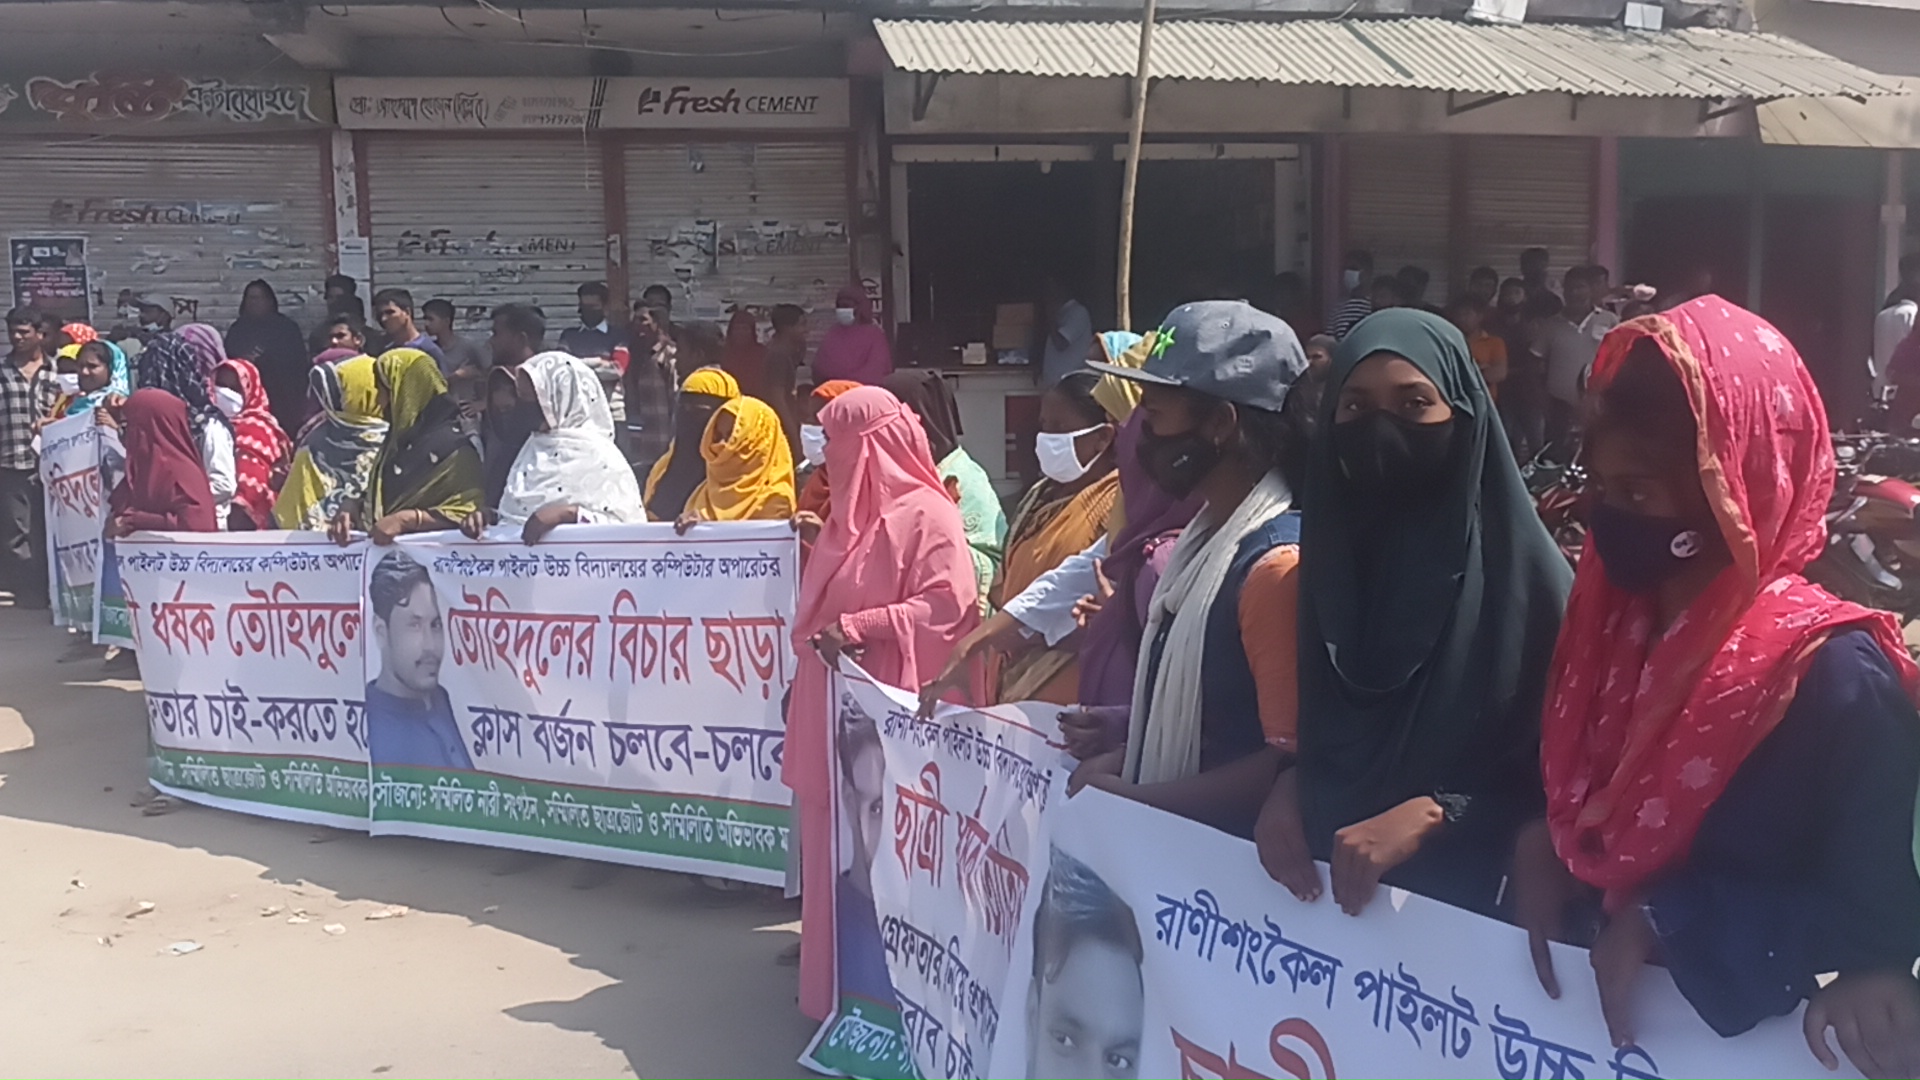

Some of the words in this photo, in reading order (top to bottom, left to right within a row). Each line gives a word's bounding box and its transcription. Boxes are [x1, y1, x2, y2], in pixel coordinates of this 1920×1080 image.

[663, 86, 741, 114] Fresh
[745, 95, 819, 112] CEMENT
[127, 551, 167, 573] পাইলট
[169, 551, 194, 573] উচ্চ
[196, 550, 256, 574] বিদ্যালয়ের
[258, 550, 321, 573] কম্পিউটার
[498, 552, 540, 578] পাইলট
[544, 552, 571, 577] উচ্চ
[575, 551, 648, 579] বিদ্যালয়ের
[651, 551, 716, 579] কম্পিউটার
[718, 549, 781, 579] অপারেটর
[150, 579, 216, 656] ধর্ষক
[447, 583, 602, 696] তৌহিদুলের
[608, 588, 694, 686] বিচার
[699, 608, 787, 701] ছাড়া
[466, 704, 524, 758] ক্লাস
[526, 698, 598, 769] বর্জন
[269, 770, 281, 790] ও
[477, 780, 501, 818] নারী
[647, 811, 660, 837] ও
[716, 808, 776, 853] অভিভাবক
[893, 760, 951, 888] ছাত্রী
[881, 913, 945, 989] গ্রেফতার
[1154, 888, 1344, 1011] রাণীশংকৈল
[1353, 960, 1481, 1060] পাইলট
[1487, 1003, 1597, 1080] উচ্চ
